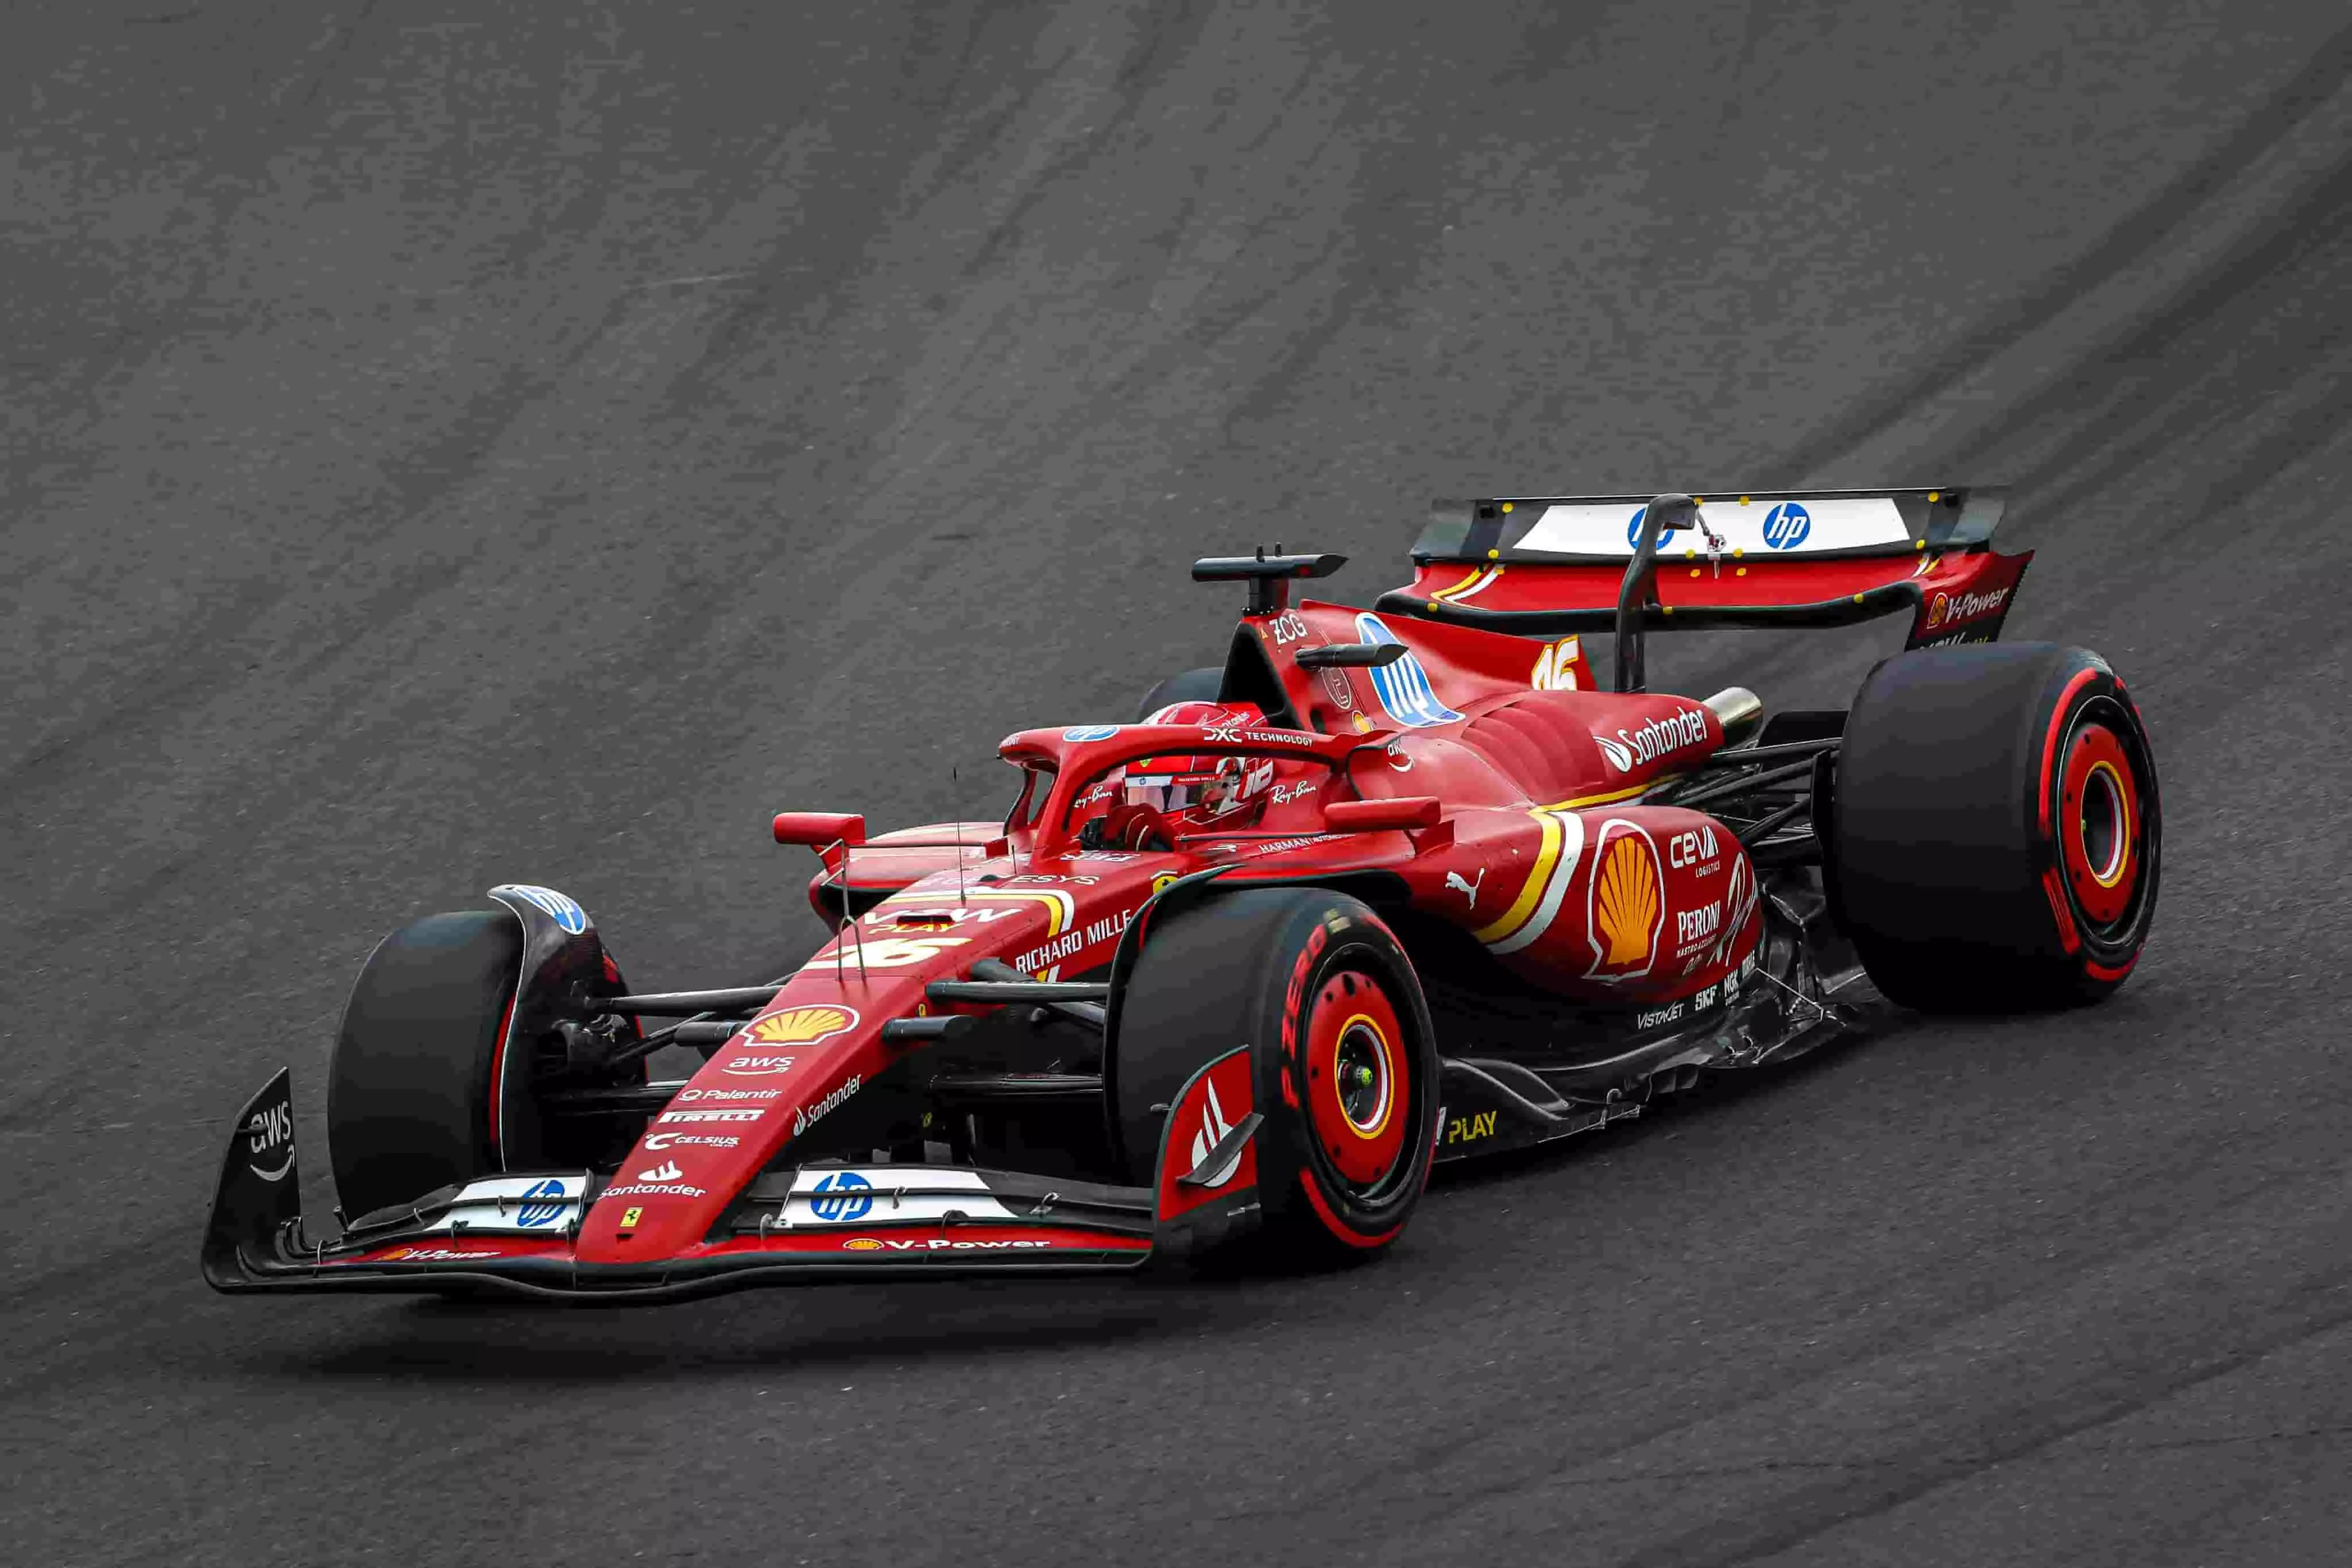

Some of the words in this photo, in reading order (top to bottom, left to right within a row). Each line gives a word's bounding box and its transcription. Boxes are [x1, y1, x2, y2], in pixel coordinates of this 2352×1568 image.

[1765, 503, 1809, 549] hp
[1945, 587, 2009, 624] V-Power
[1269, 614, 1308, 645] ZCG
[1244, 731, 1313, 748] TECHNOLOGY
[1617, 706, 1708, 765] Santander
[1074, 785, 1113, 809] ay-Ban
[1270, 780, 1316, 804] Ray-Ban
[1259, 837, 1312, 854] HARMAN
[868, 923, 965, 934] PLAY
[1677, 900, 1720, 944] PERONI
[1015, 930, 1083, 974] RICHARD
[1695, 985, 1718, 1011] SKF
[729, 1057, 795, 1068] aws
[702, 1089, 782, 1099] Palantir
[806, 1074, 862, 1128] Santander
[251, 1101, 291, 1153] aws
[658, 1109, 765, 1124] PIRELLI
[1449, 1110, 1497, 1144] PLAY
[675, 1136, 740, 1144] CELSIUS
[885, 1240, 1052, 1250] V-Power
